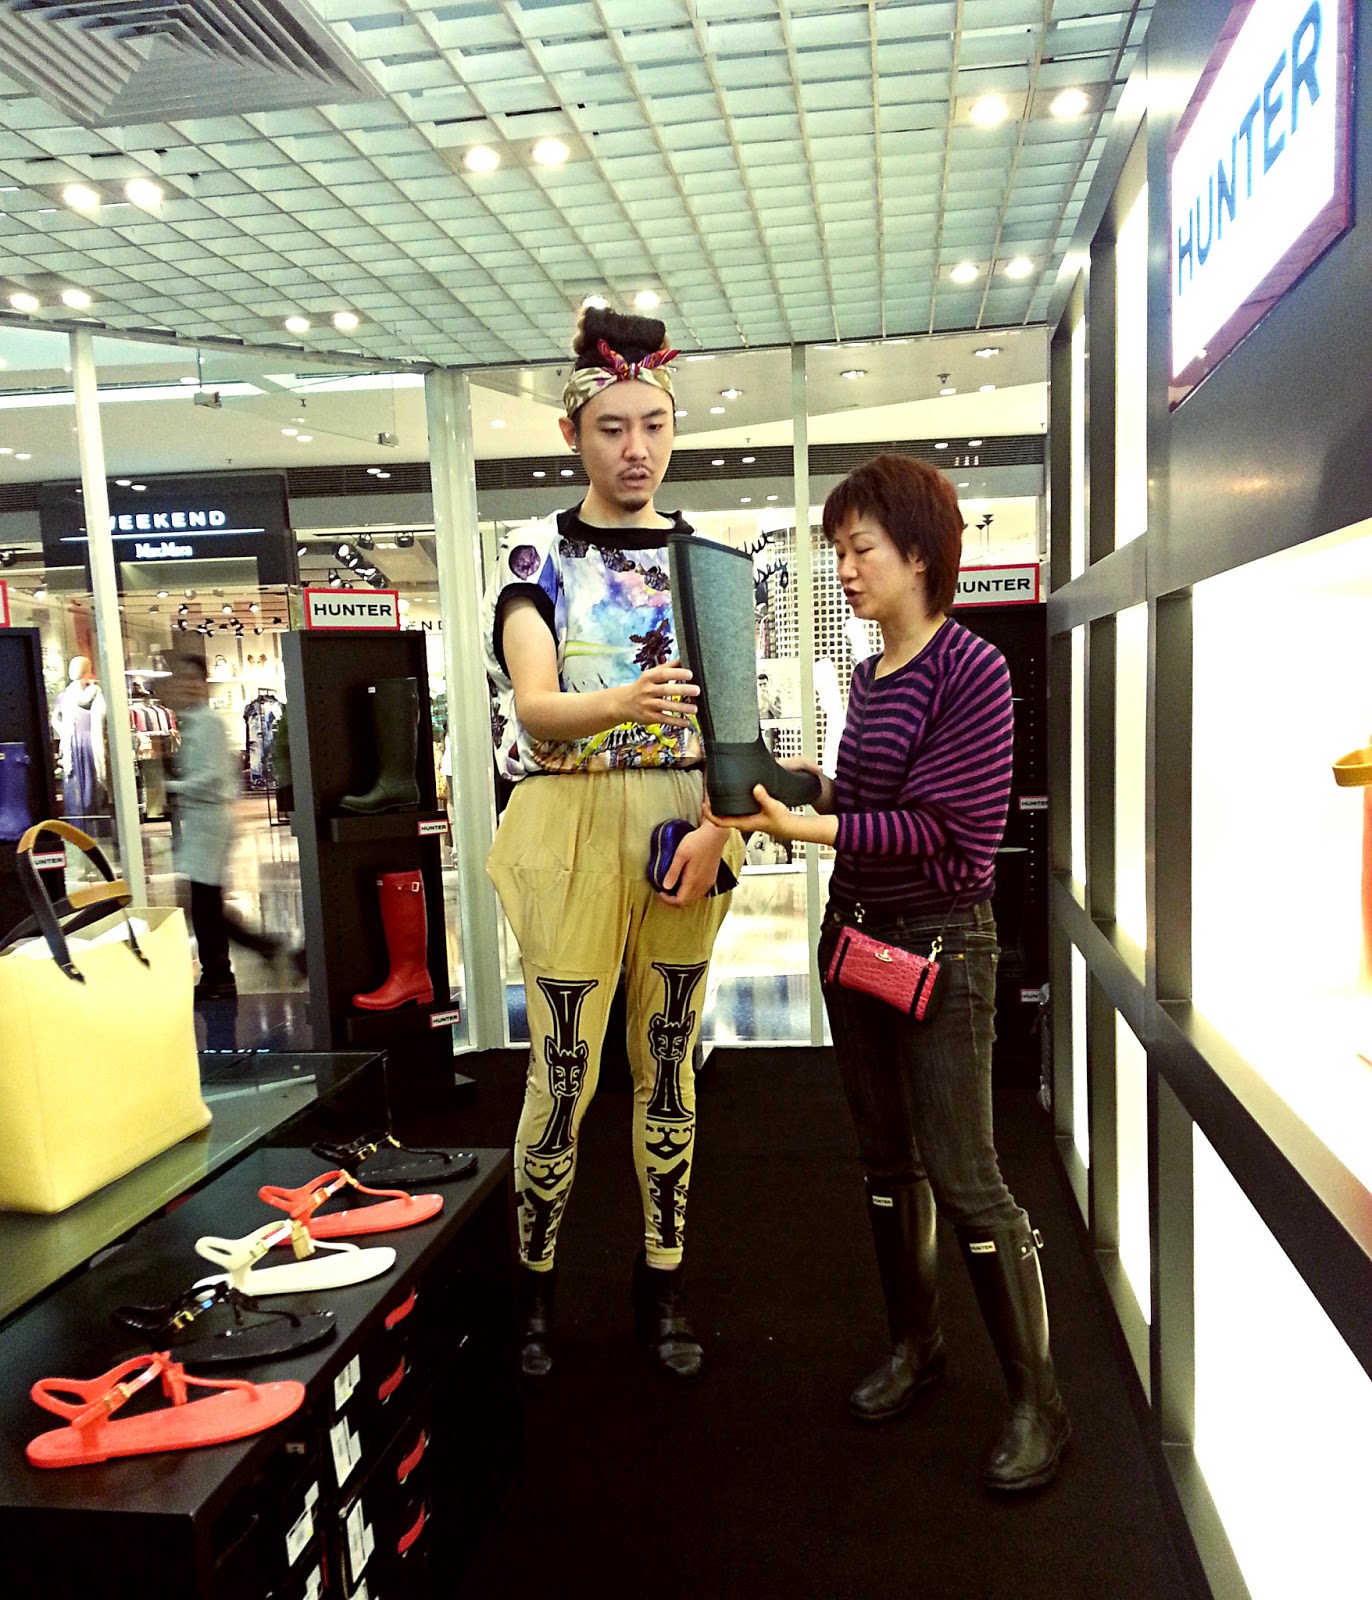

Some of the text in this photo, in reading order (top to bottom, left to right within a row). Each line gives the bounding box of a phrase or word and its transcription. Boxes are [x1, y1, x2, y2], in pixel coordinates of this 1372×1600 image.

[1178, 0, 1323, 297] HUNTER
[314, 603, 392, 616] HUNTER
[34, 857, 62, 865] UNTER
[433, 1015, 458, 1023] HUNTER
